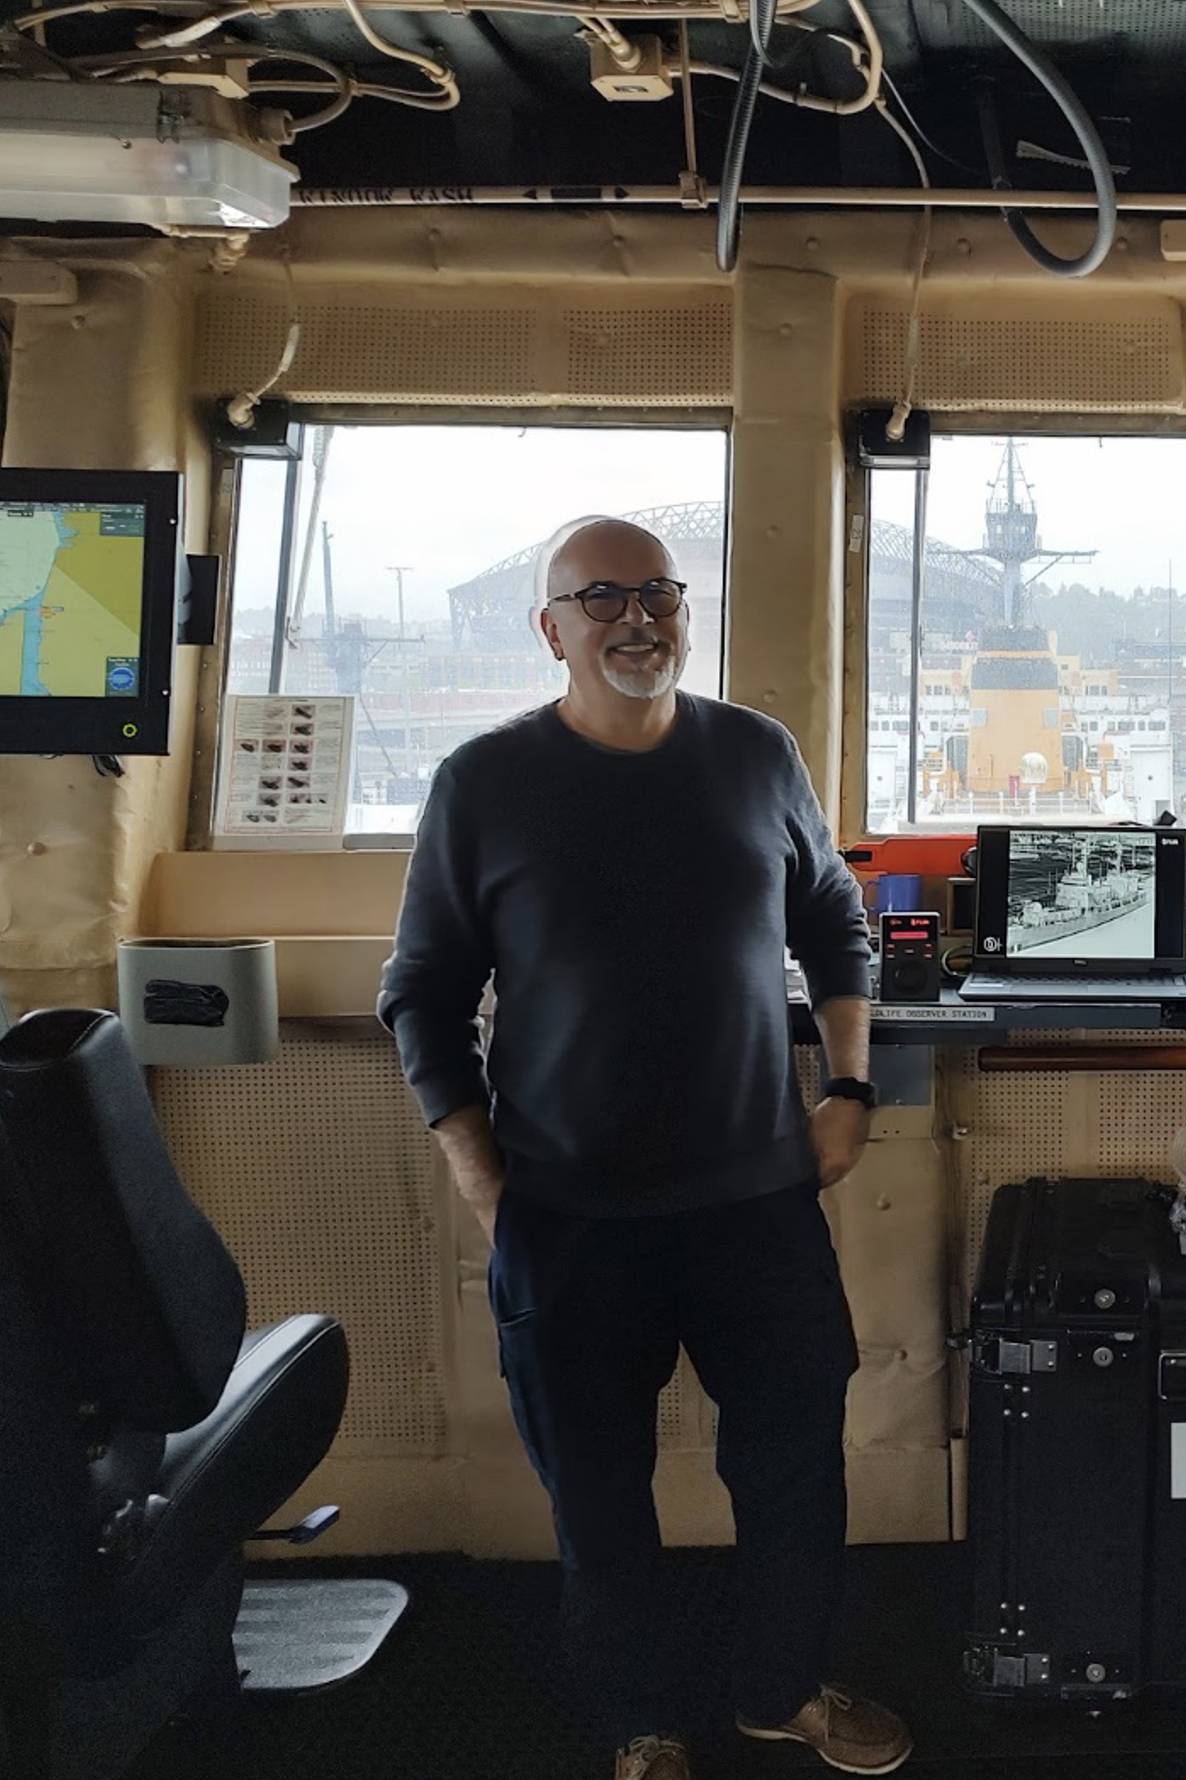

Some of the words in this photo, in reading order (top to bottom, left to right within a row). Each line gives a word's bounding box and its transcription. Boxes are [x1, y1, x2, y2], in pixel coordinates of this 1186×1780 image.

[409, 187, 472, 202] WASH
[906, 1010, 948, 1018] OBSERVER
[952, 1010, 987, 1018] STATION
